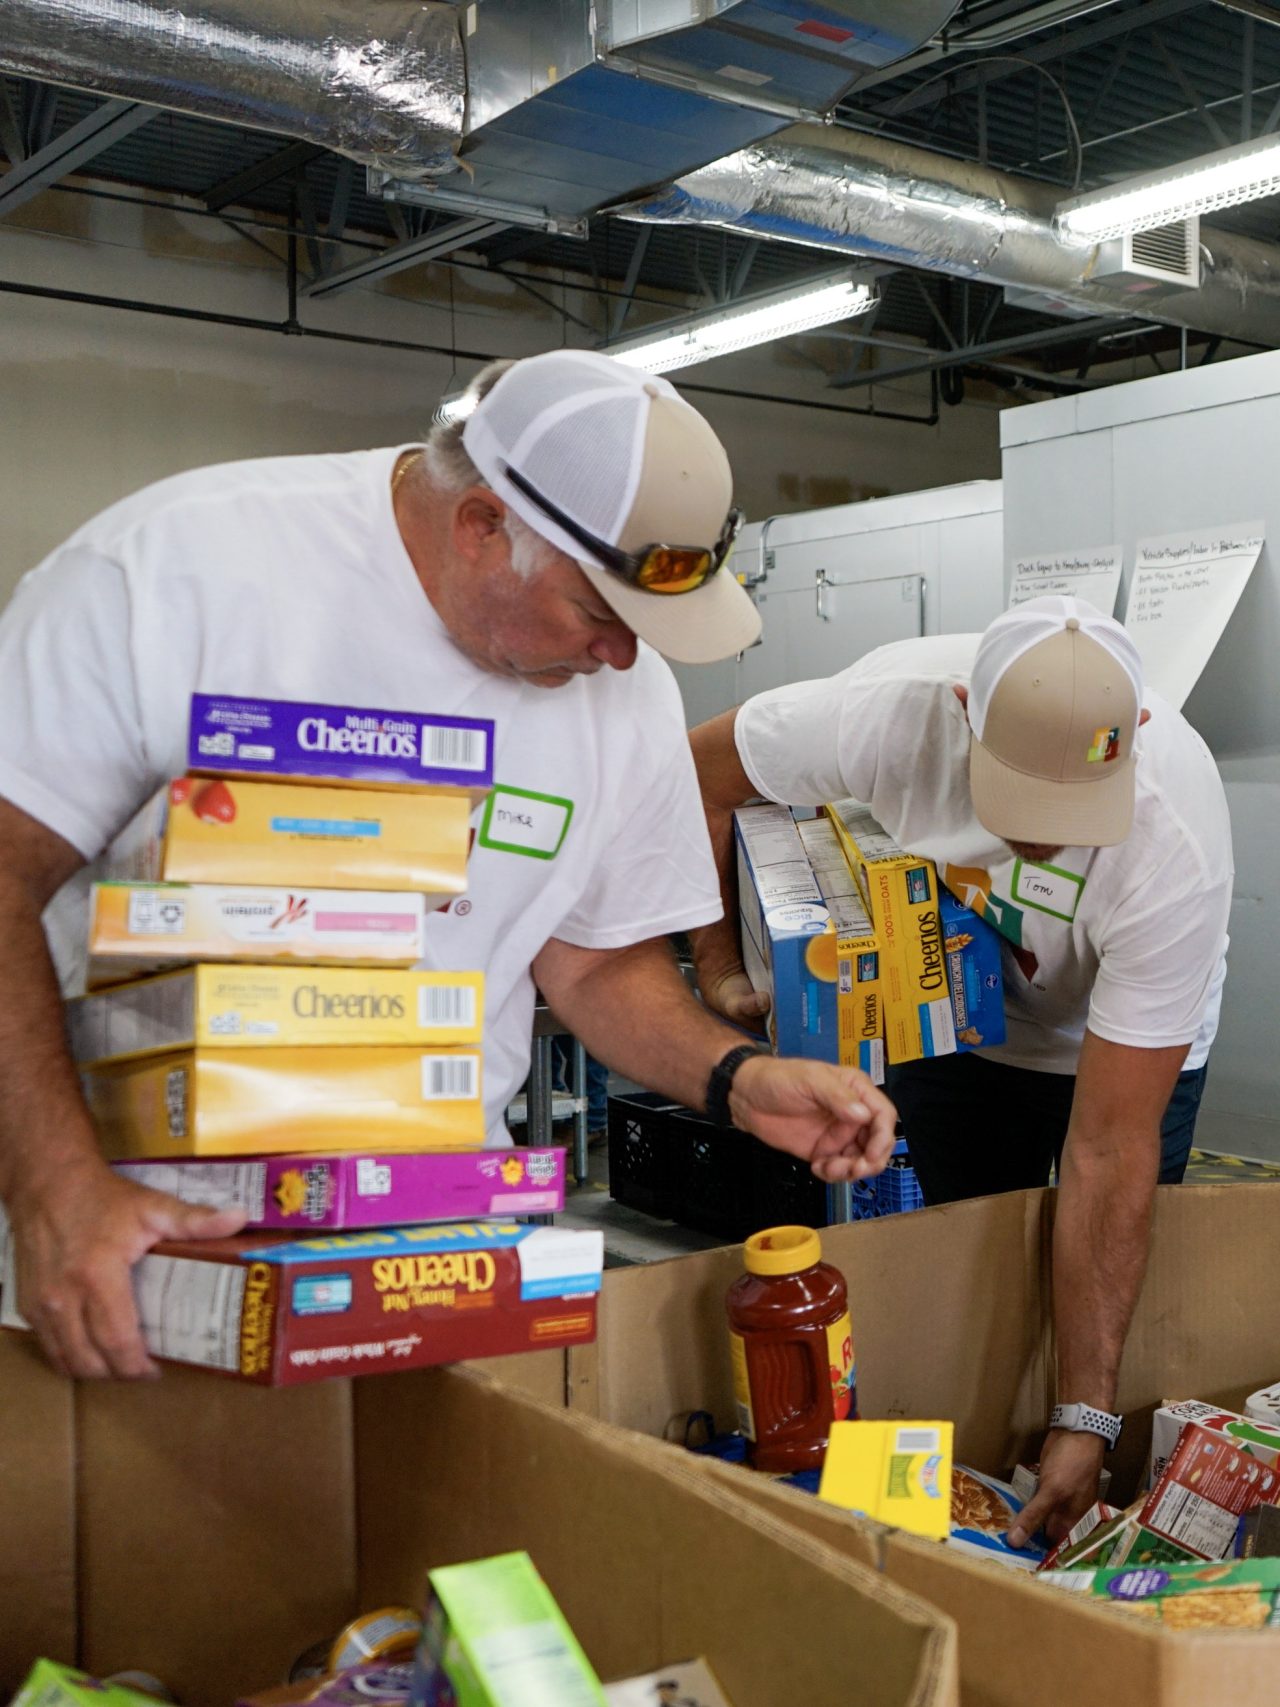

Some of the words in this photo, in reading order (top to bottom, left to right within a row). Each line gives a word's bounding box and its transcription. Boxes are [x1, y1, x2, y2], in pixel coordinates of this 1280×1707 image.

[296, 717, 418, 759] Cheerios
[1023, 876, 1054, 897] Tom
[917, 911, 944, 991] Cheerios
[291, 985, 406, 1020] Cheerios
[861, 993, 877, 1038] Cheerios
[373, 1251, 497, 1292] Cheerios
